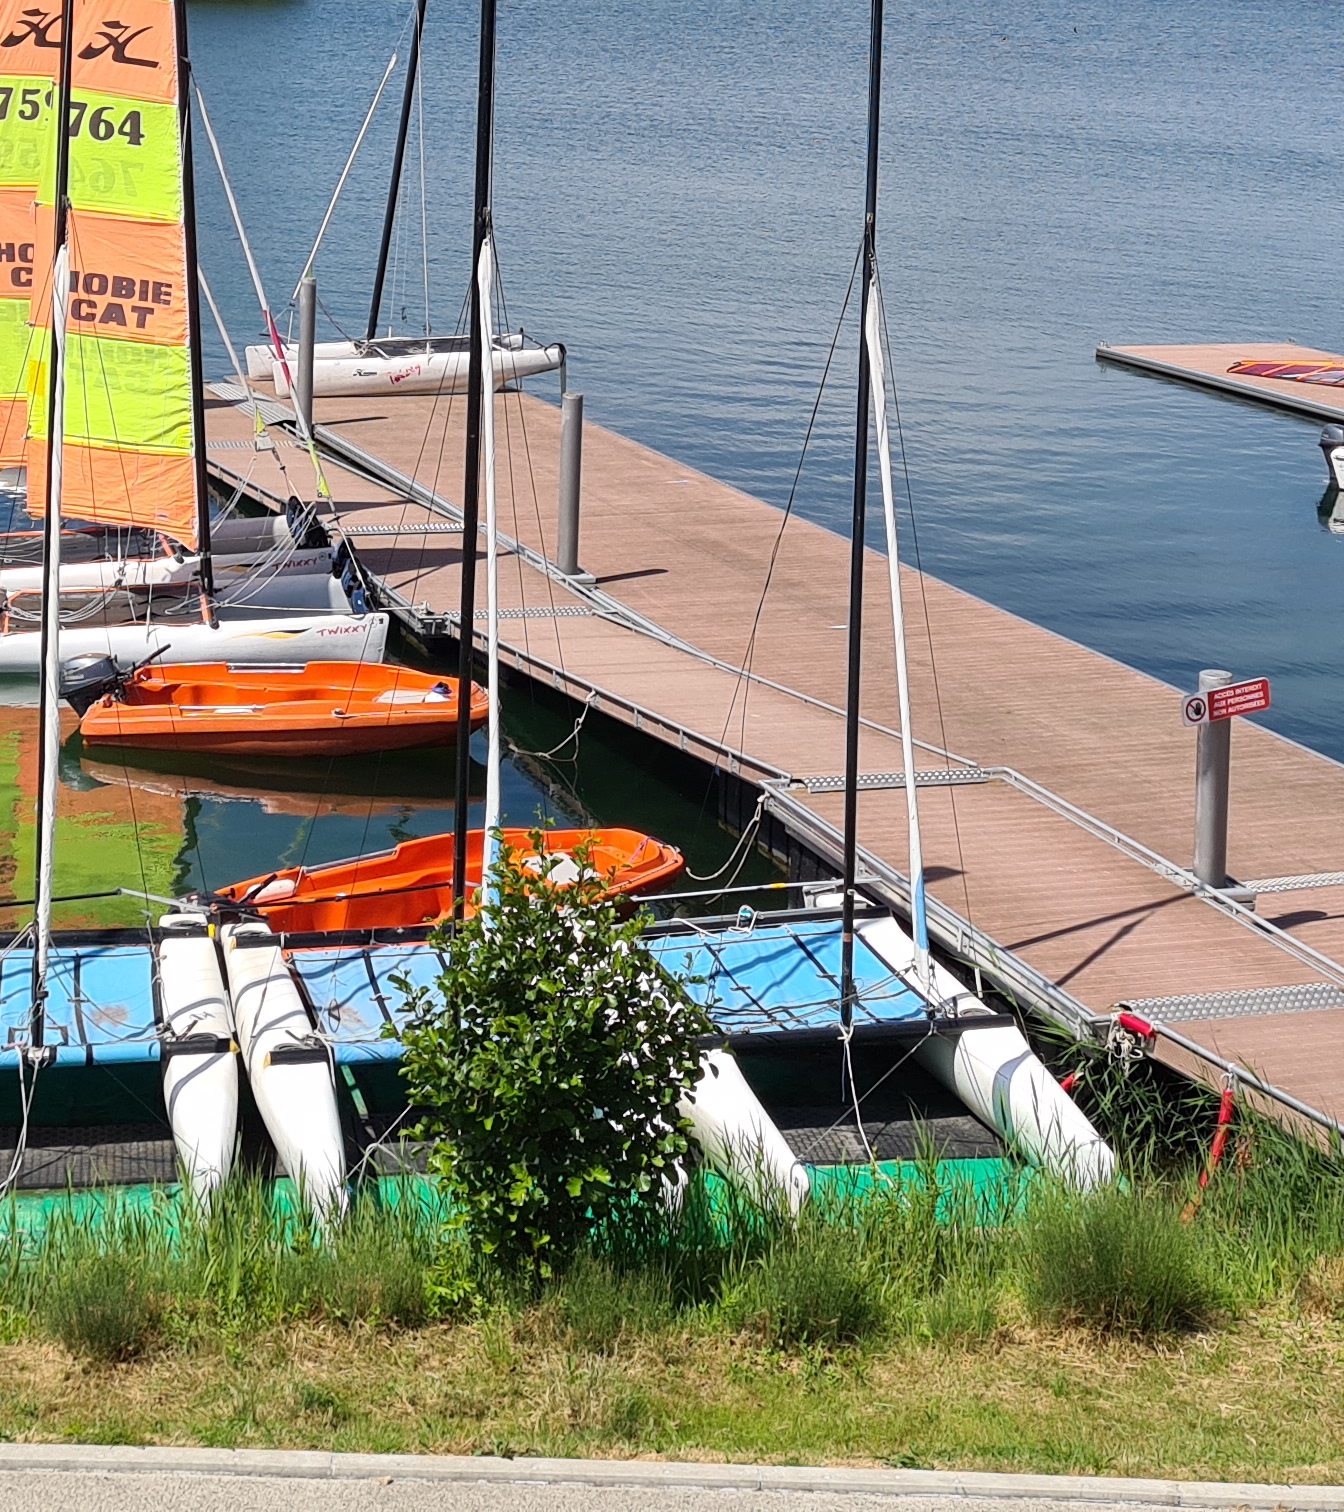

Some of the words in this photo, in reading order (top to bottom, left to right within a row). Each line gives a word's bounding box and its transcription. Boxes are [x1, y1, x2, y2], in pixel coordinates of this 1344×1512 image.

[69, 101, 146, 147] 764
[70, 297, 155, 330] CAT
[271, 556, 318, 570] TWIXXY
[316, 623, 368, 637] TWIXXY
